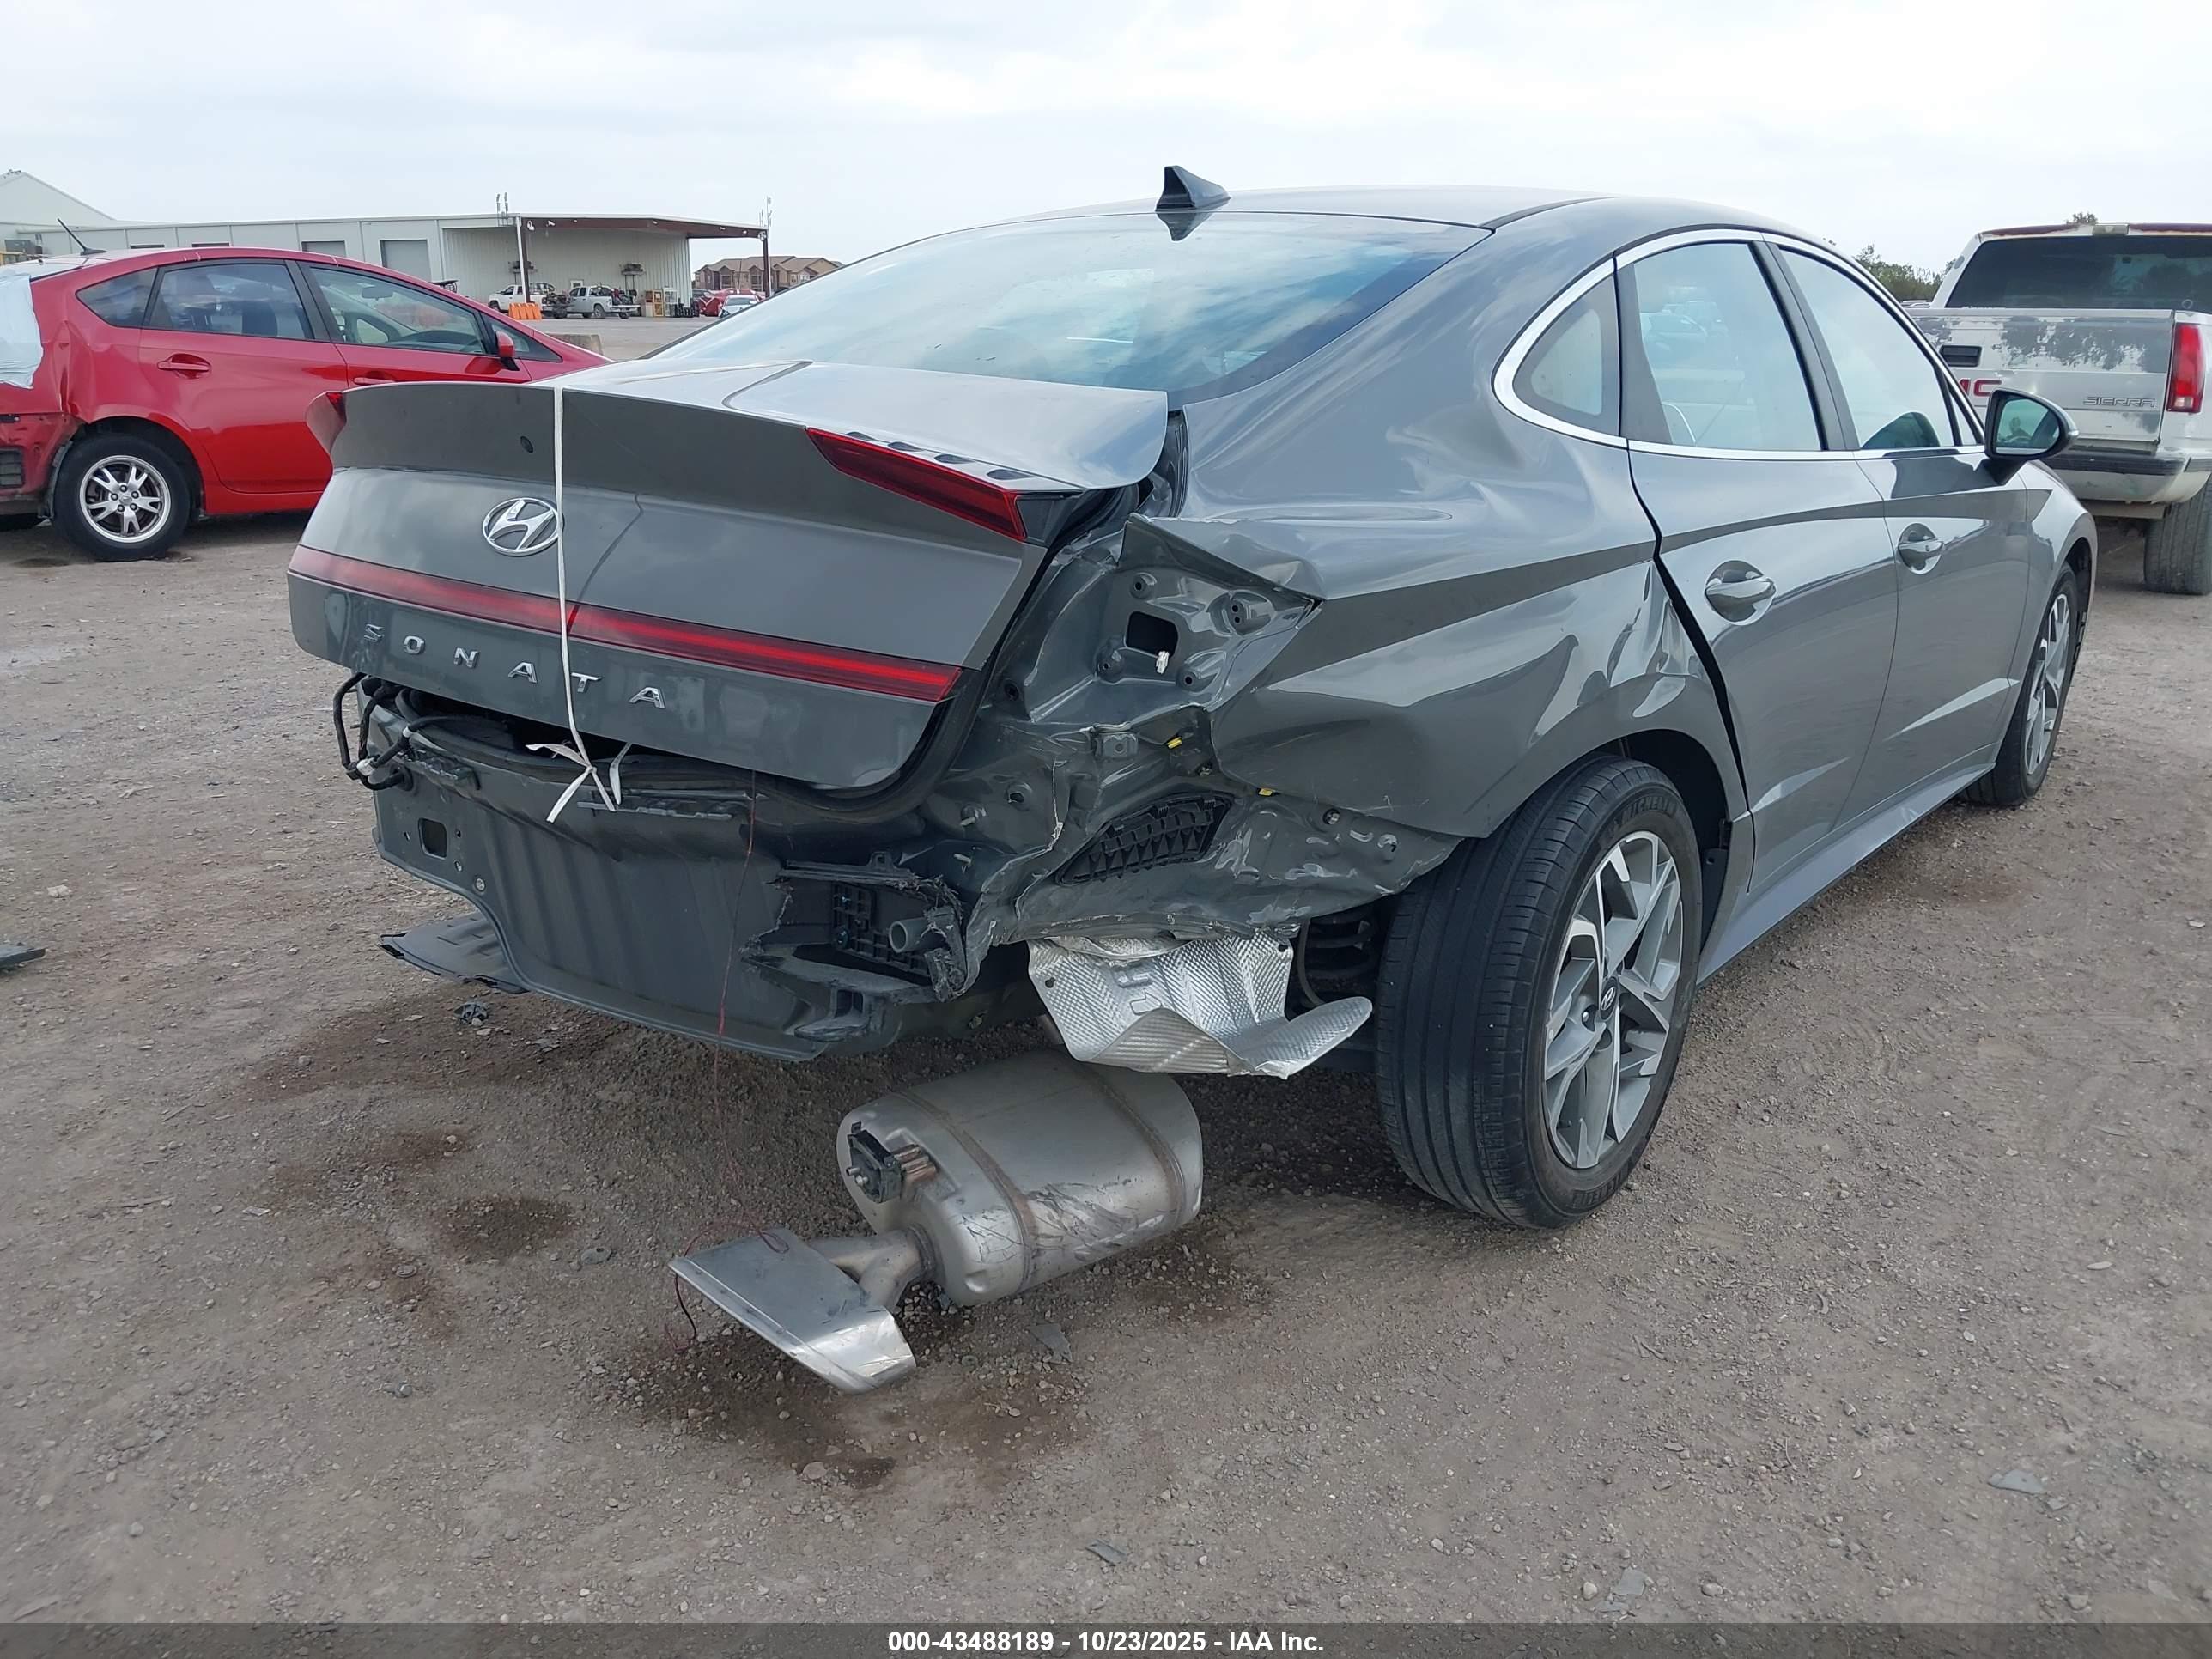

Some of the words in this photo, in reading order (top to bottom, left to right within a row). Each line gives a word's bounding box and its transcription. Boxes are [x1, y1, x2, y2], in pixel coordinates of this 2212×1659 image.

[2083, 396, 2157, 408] SIERRA
[363, 623, 666, 709] SONATA
[1621, 796, 1677, 824] MICHELIN
